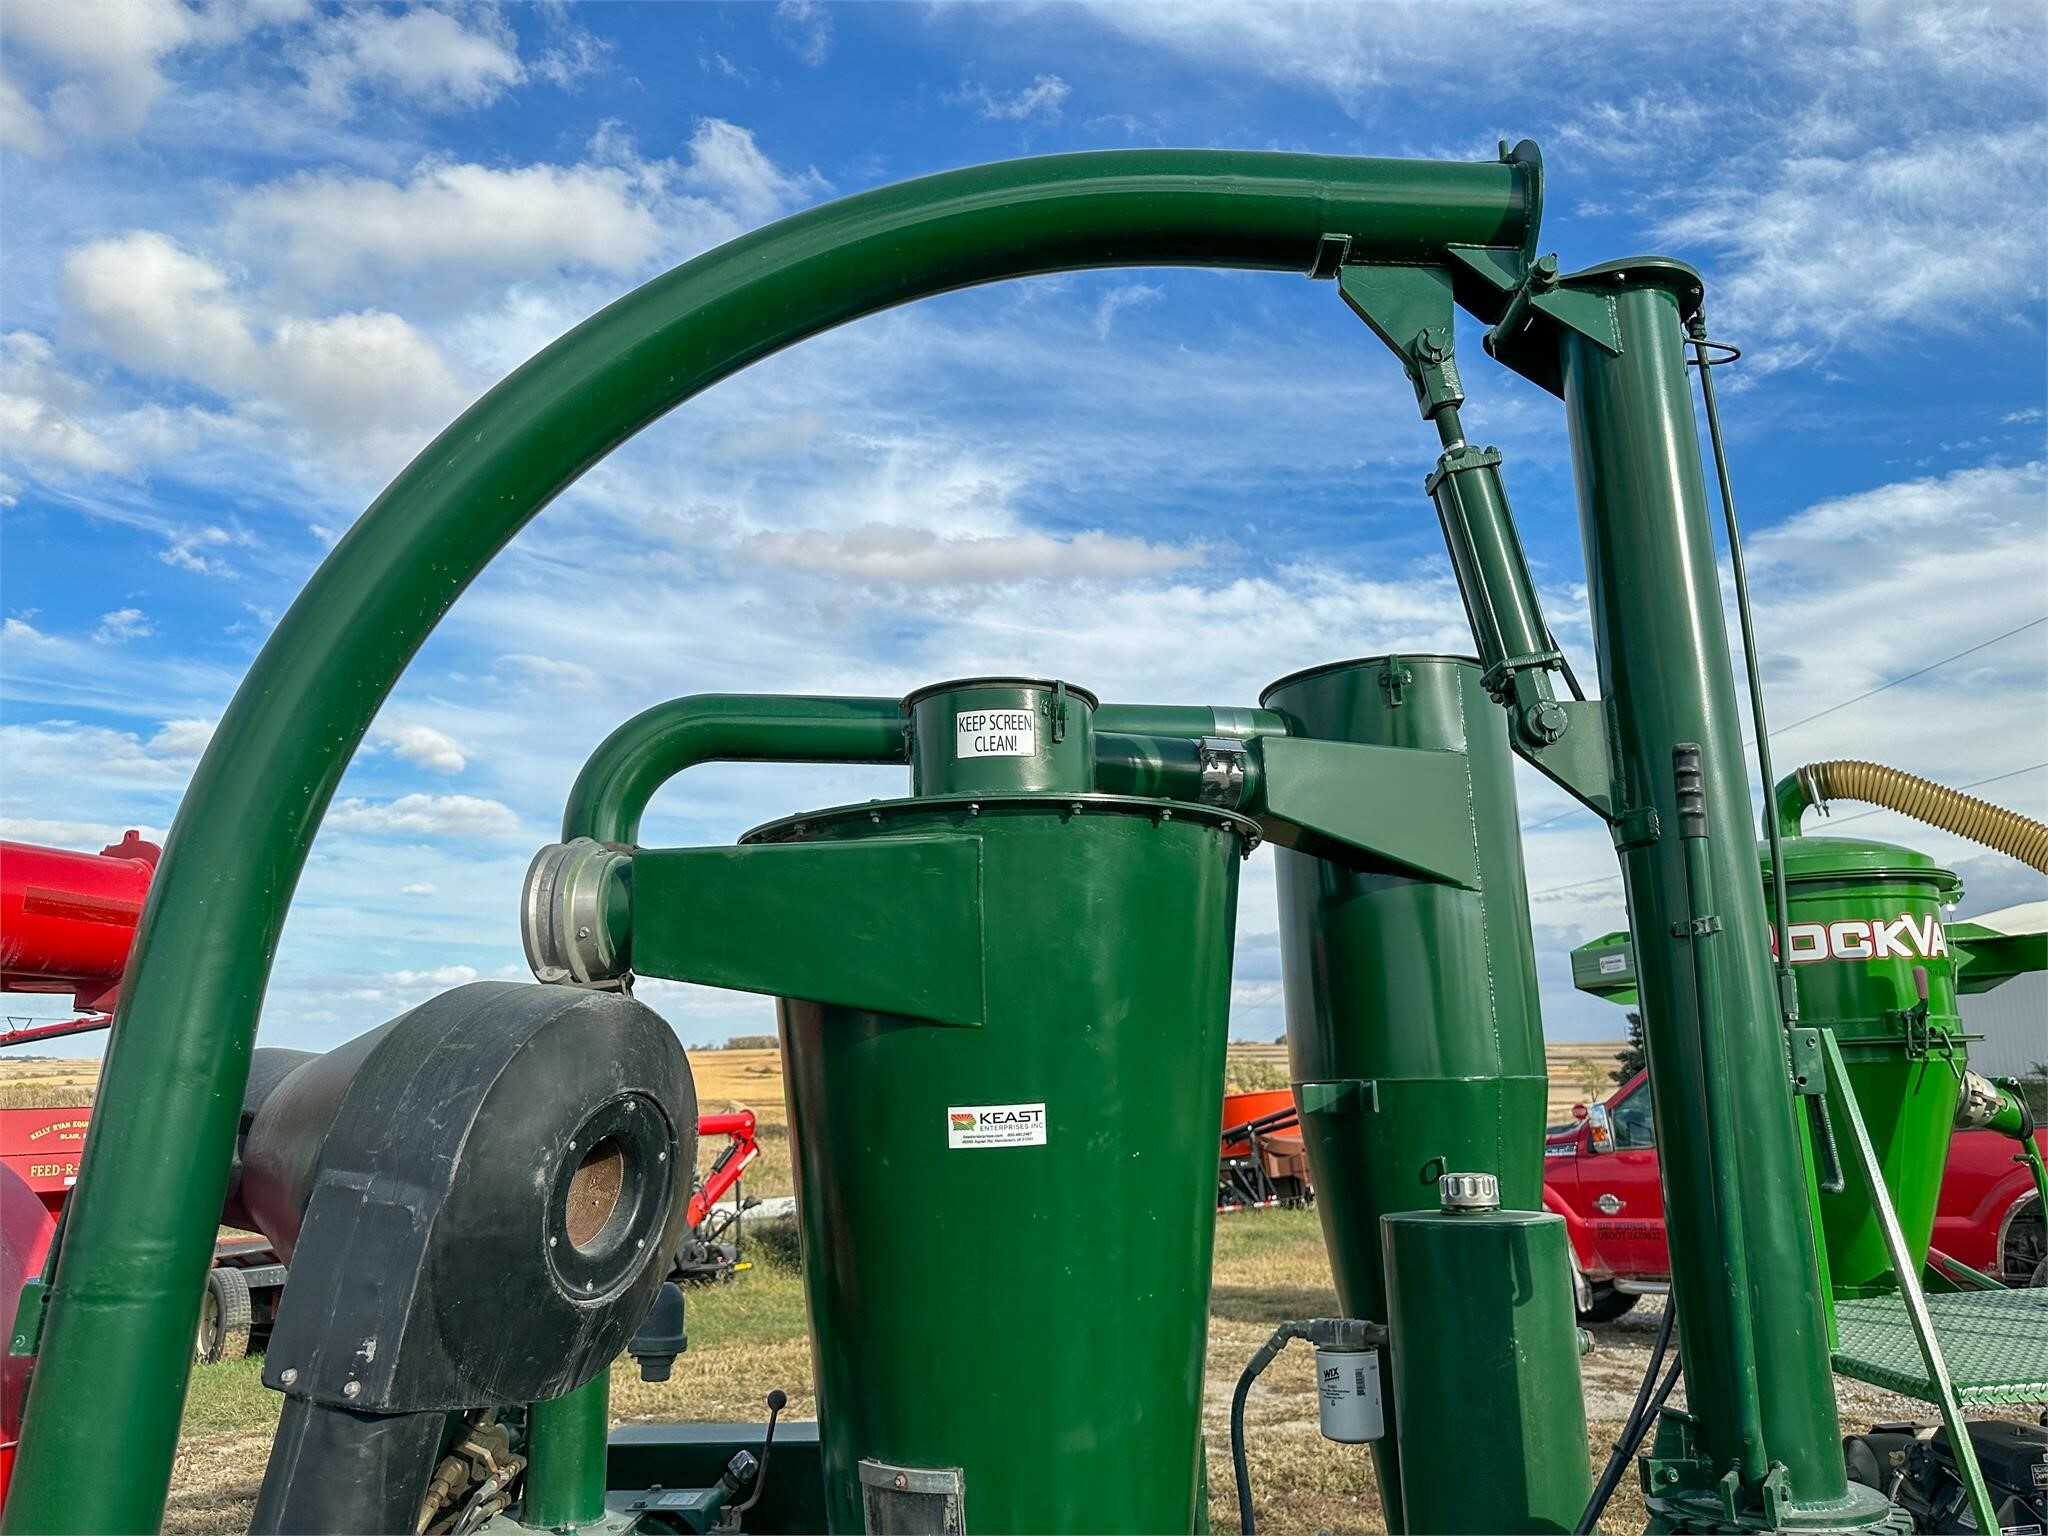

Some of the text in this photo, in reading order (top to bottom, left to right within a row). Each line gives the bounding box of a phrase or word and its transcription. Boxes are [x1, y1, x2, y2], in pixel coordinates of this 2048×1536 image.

[958, 714, 1032, 733] KEEP SCREEN
[974, 735, 1017, 752] CLEAN!
[1768, 912, 1949, 963] OCKVA
[979, 1110, 1043, 1125] KEAST
[30, 1126, 50, 1140] KELLY
[52, 1121, 71, 1131] RYAN
[979, 1123, 1029, 1132] ENTERPRISES
[30, 1163, 80, 1177] FEED-R-
[1323, 1367, 1339, 1378] WIX
